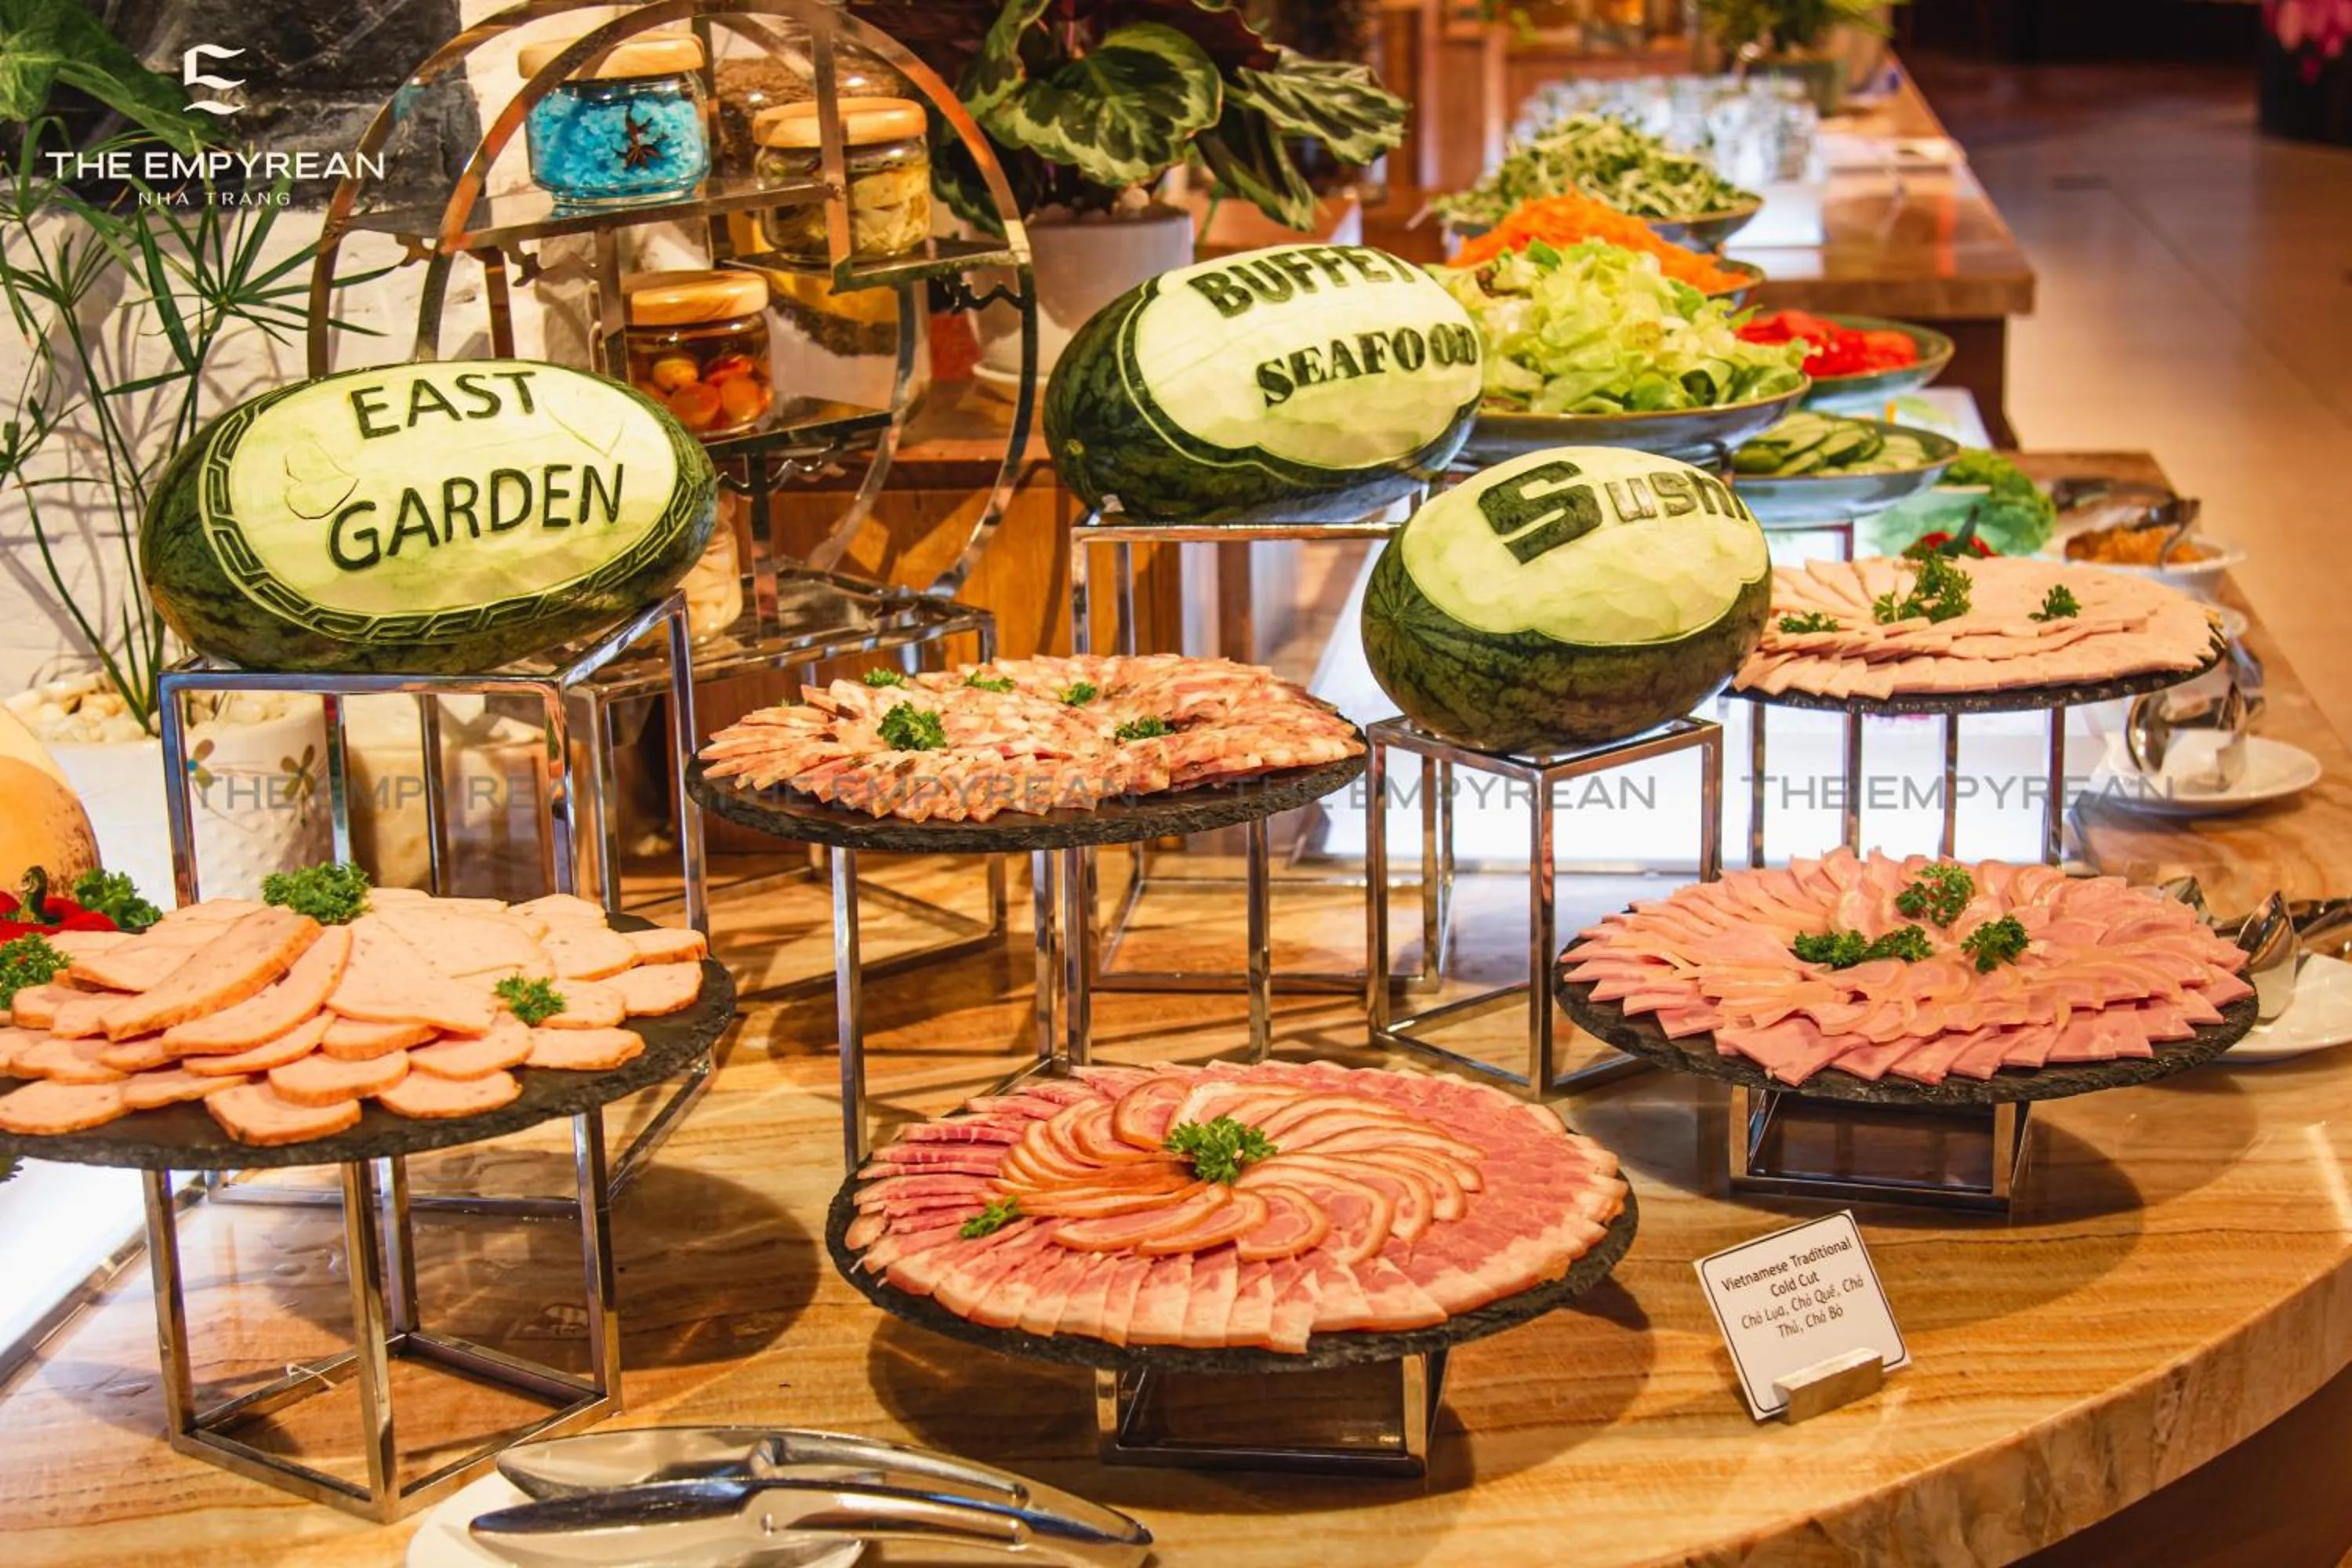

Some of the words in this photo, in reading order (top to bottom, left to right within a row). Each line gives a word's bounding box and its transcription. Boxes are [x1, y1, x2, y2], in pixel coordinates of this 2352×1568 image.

[1254, 322, 1479, 409] SEAFOOD
[350, 370, 536, 440] EAST
[328, 463, 625, 572] GARDEN
[1721, 1261, 1788, 1292] Vietnamese
[1789, 1236, 1853, 1268] Traditional
[1769, 1277, 1798, 1298] Cold
[1798, 1271, 1820, 1287] Cut
